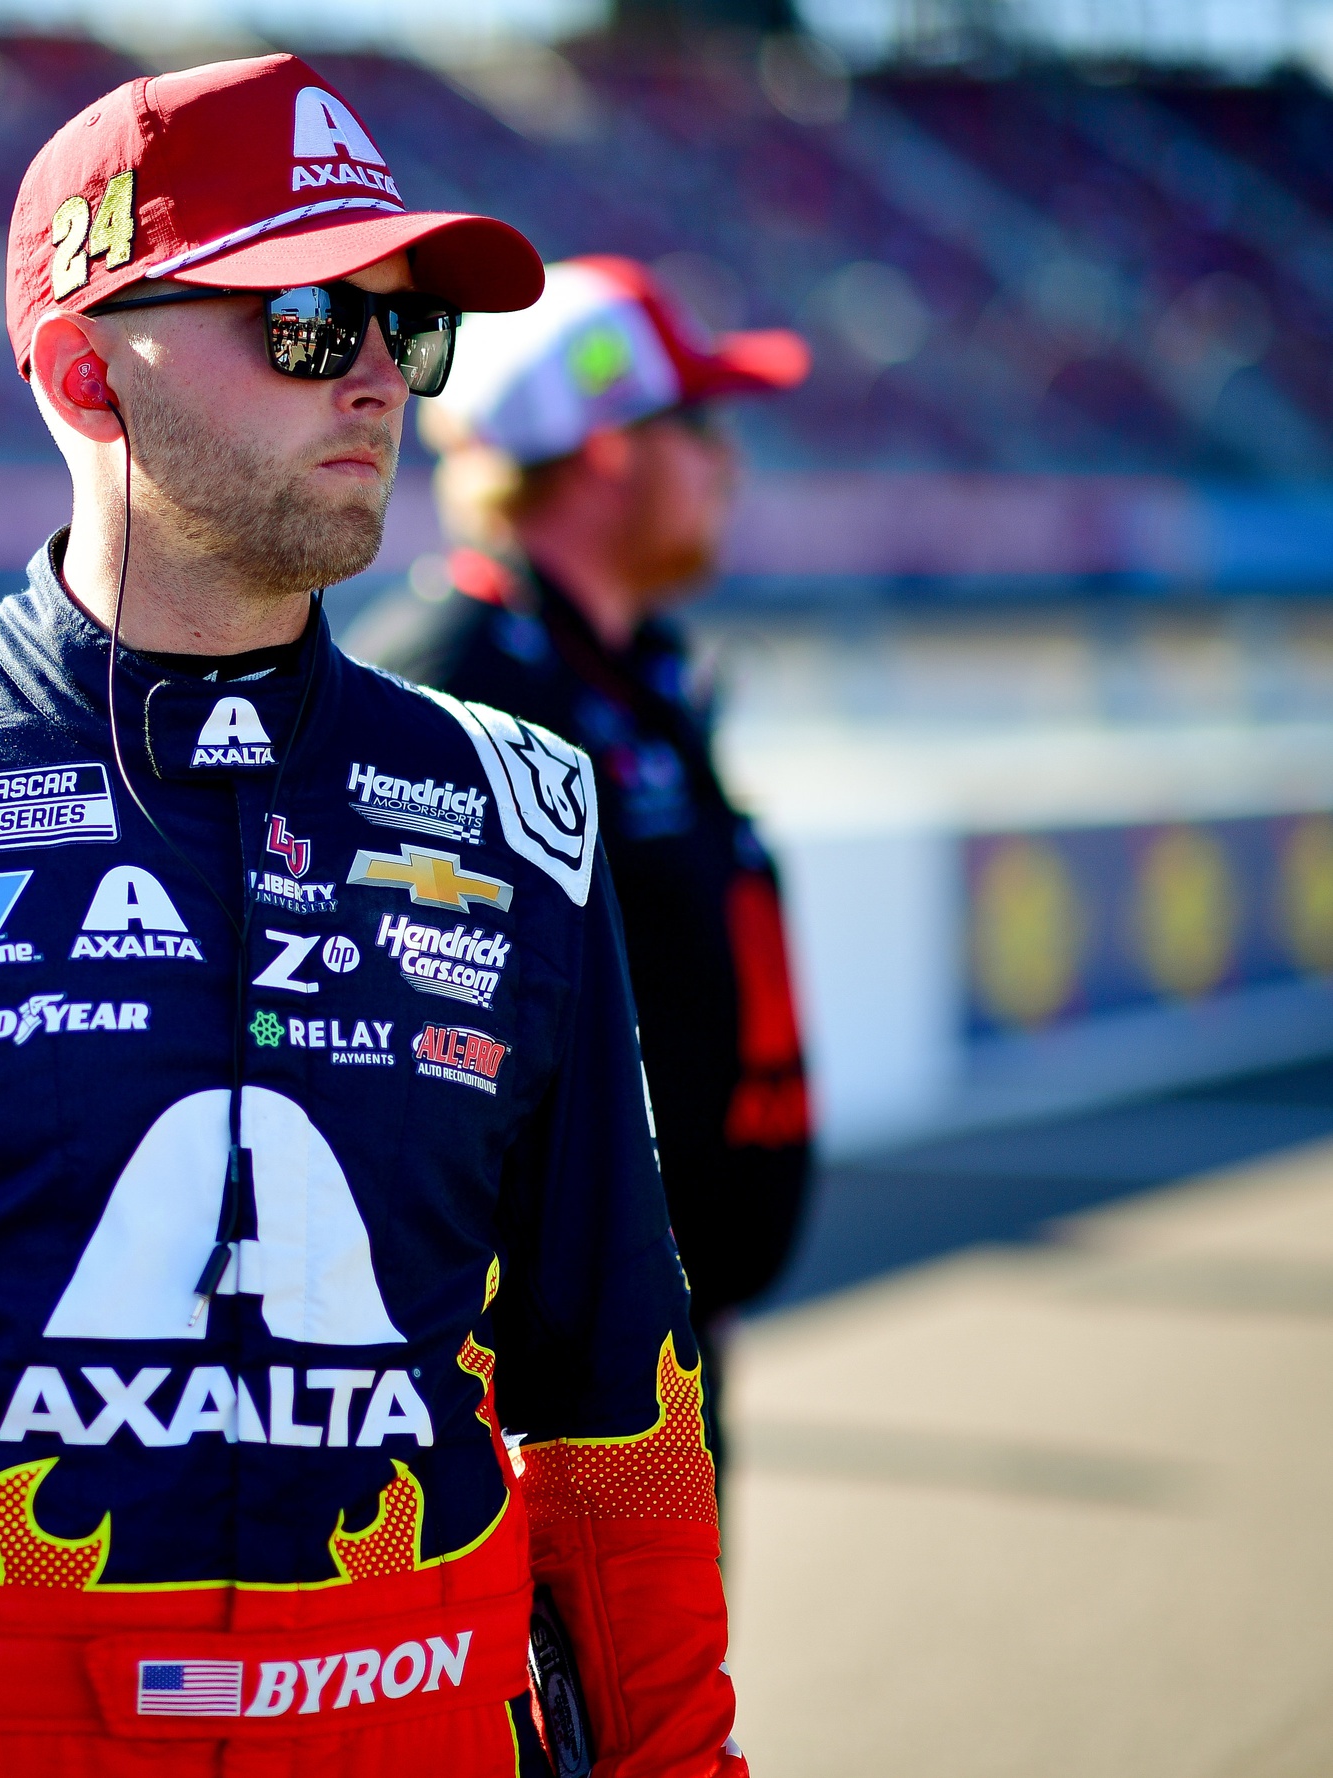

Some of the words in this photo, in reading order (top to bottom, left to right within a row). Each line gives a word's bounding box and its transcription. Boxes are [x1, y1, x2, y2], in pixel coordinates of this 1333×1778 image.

[292, 163, 403, 202] AXALTA
[52, 170, 134, 300] 24
[192, 747, 276, 766] AXALTA
[349, 763, 488, 817] Hendrick
[0, 804, 86, 832] SERIES
[372, 796, 484, 829] MOTORSPORTS
[71, 934, 204, 961] AXALTA
[375, 914, 513, 968] Hendrick
[400, 953, 499, 992] Cars.com
[290, 1019, 394, 1049] RELAY
[332, 1051, 395, 1066] PAYMENTS
[416, 1026, 505, 1079] ALL-PRO
[418, 1062, 443, 1078] AUTO
[443, 1066, 497, 1095] RECONDITIONING
[243, 1630, 473, 1719] BYRON
